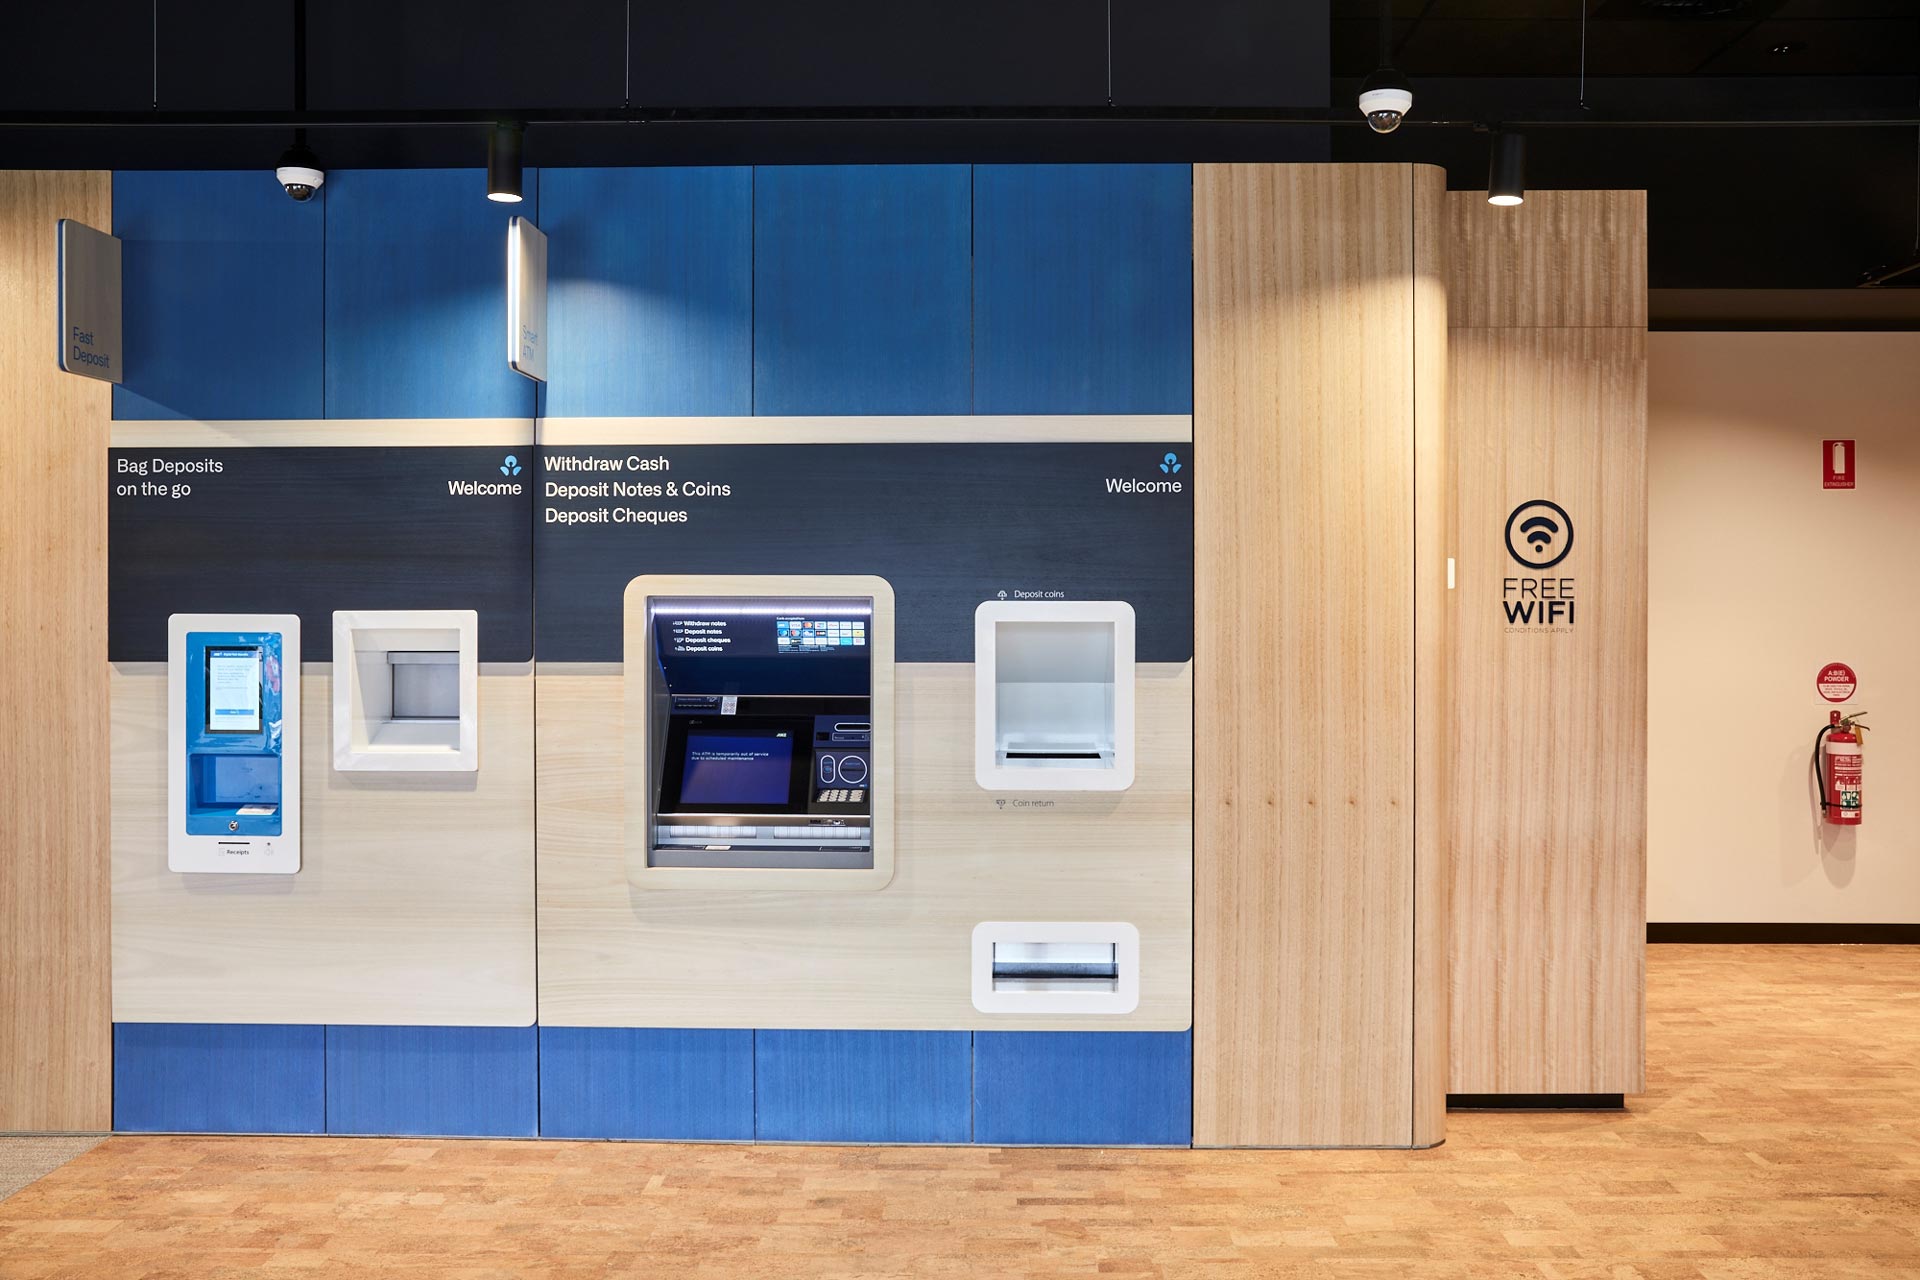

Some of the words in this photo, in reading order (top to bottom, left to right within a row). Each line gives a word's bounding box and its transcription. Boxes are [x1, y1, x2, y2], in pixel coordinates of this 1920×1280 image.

[73, 326, 94, 346] Fast
[73, 345, 110, 369] Deposit
[117, 458, 148, 476] Bag
[152, 458, 224, 475] Deposits
[544, 456, 624, 472] Withdraw
[626, 456, 670, 471] Cash
[116, 484, 137, 496] on
[141, 481, 168, 496] the
[171, 484, 191, 499] go
[448, 480, 522, 496] Welcome
[545, 481, 609, 500] Deposit
[613, 481, 662, 497] Notes
[666, 482, 679, 497] &
[682, 481, 731, 497] Coins
[1105, 478, 1182, 493] Welcome
[545, 507, 609, 526] Deposit
[612, 507, 688, 526] Cheques
[1014, 590, 1043, 599] Deposit
[1044, 590, 1065, 598] coins
[1503, 578, 1575, 599] FREE
[1502, 601, 1575, 624] WIFI
[1012, 799, 1030, 807] Coin
